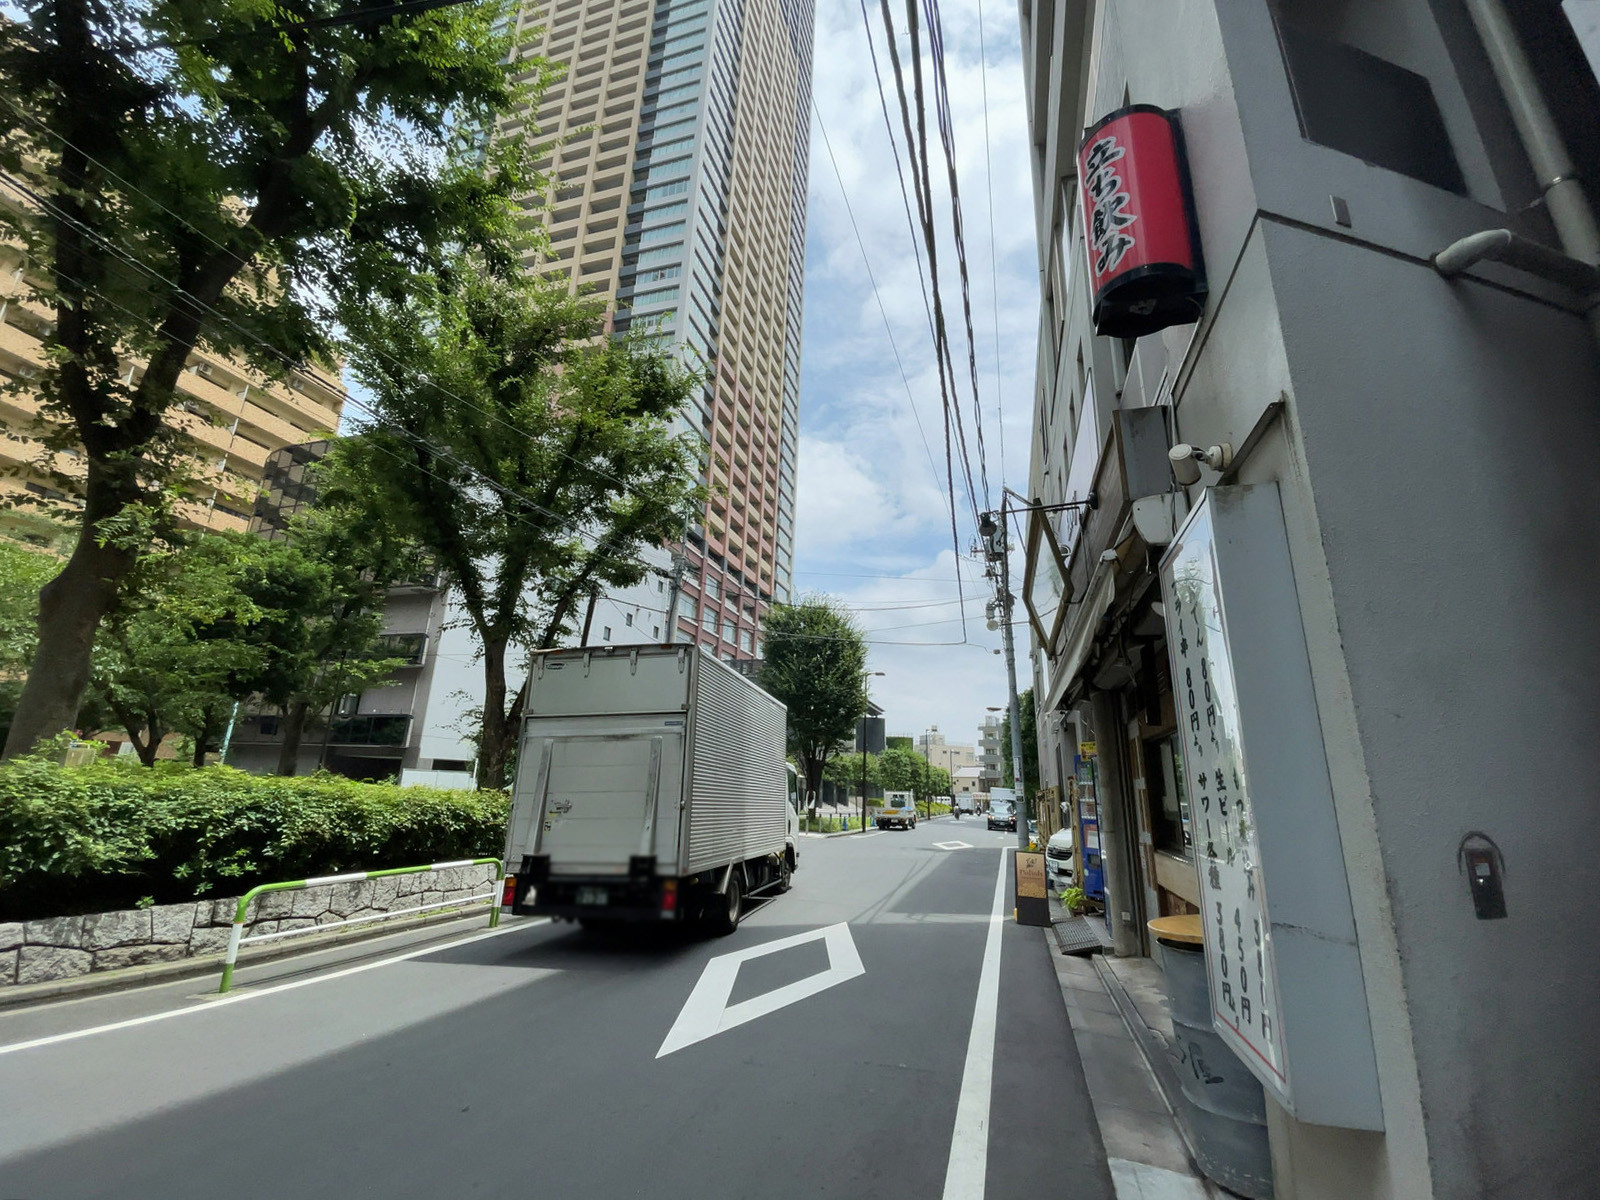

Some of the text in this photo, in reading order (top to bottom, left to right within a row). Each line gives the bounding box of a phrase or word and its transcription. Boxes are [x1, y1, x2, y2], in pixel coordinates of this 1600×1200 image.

[1084, 136, 1137, 277] 立ち飲み
[1215, 768, 1235, 867] 生ビール
[1234, 907, 1251, 1025] 450円
